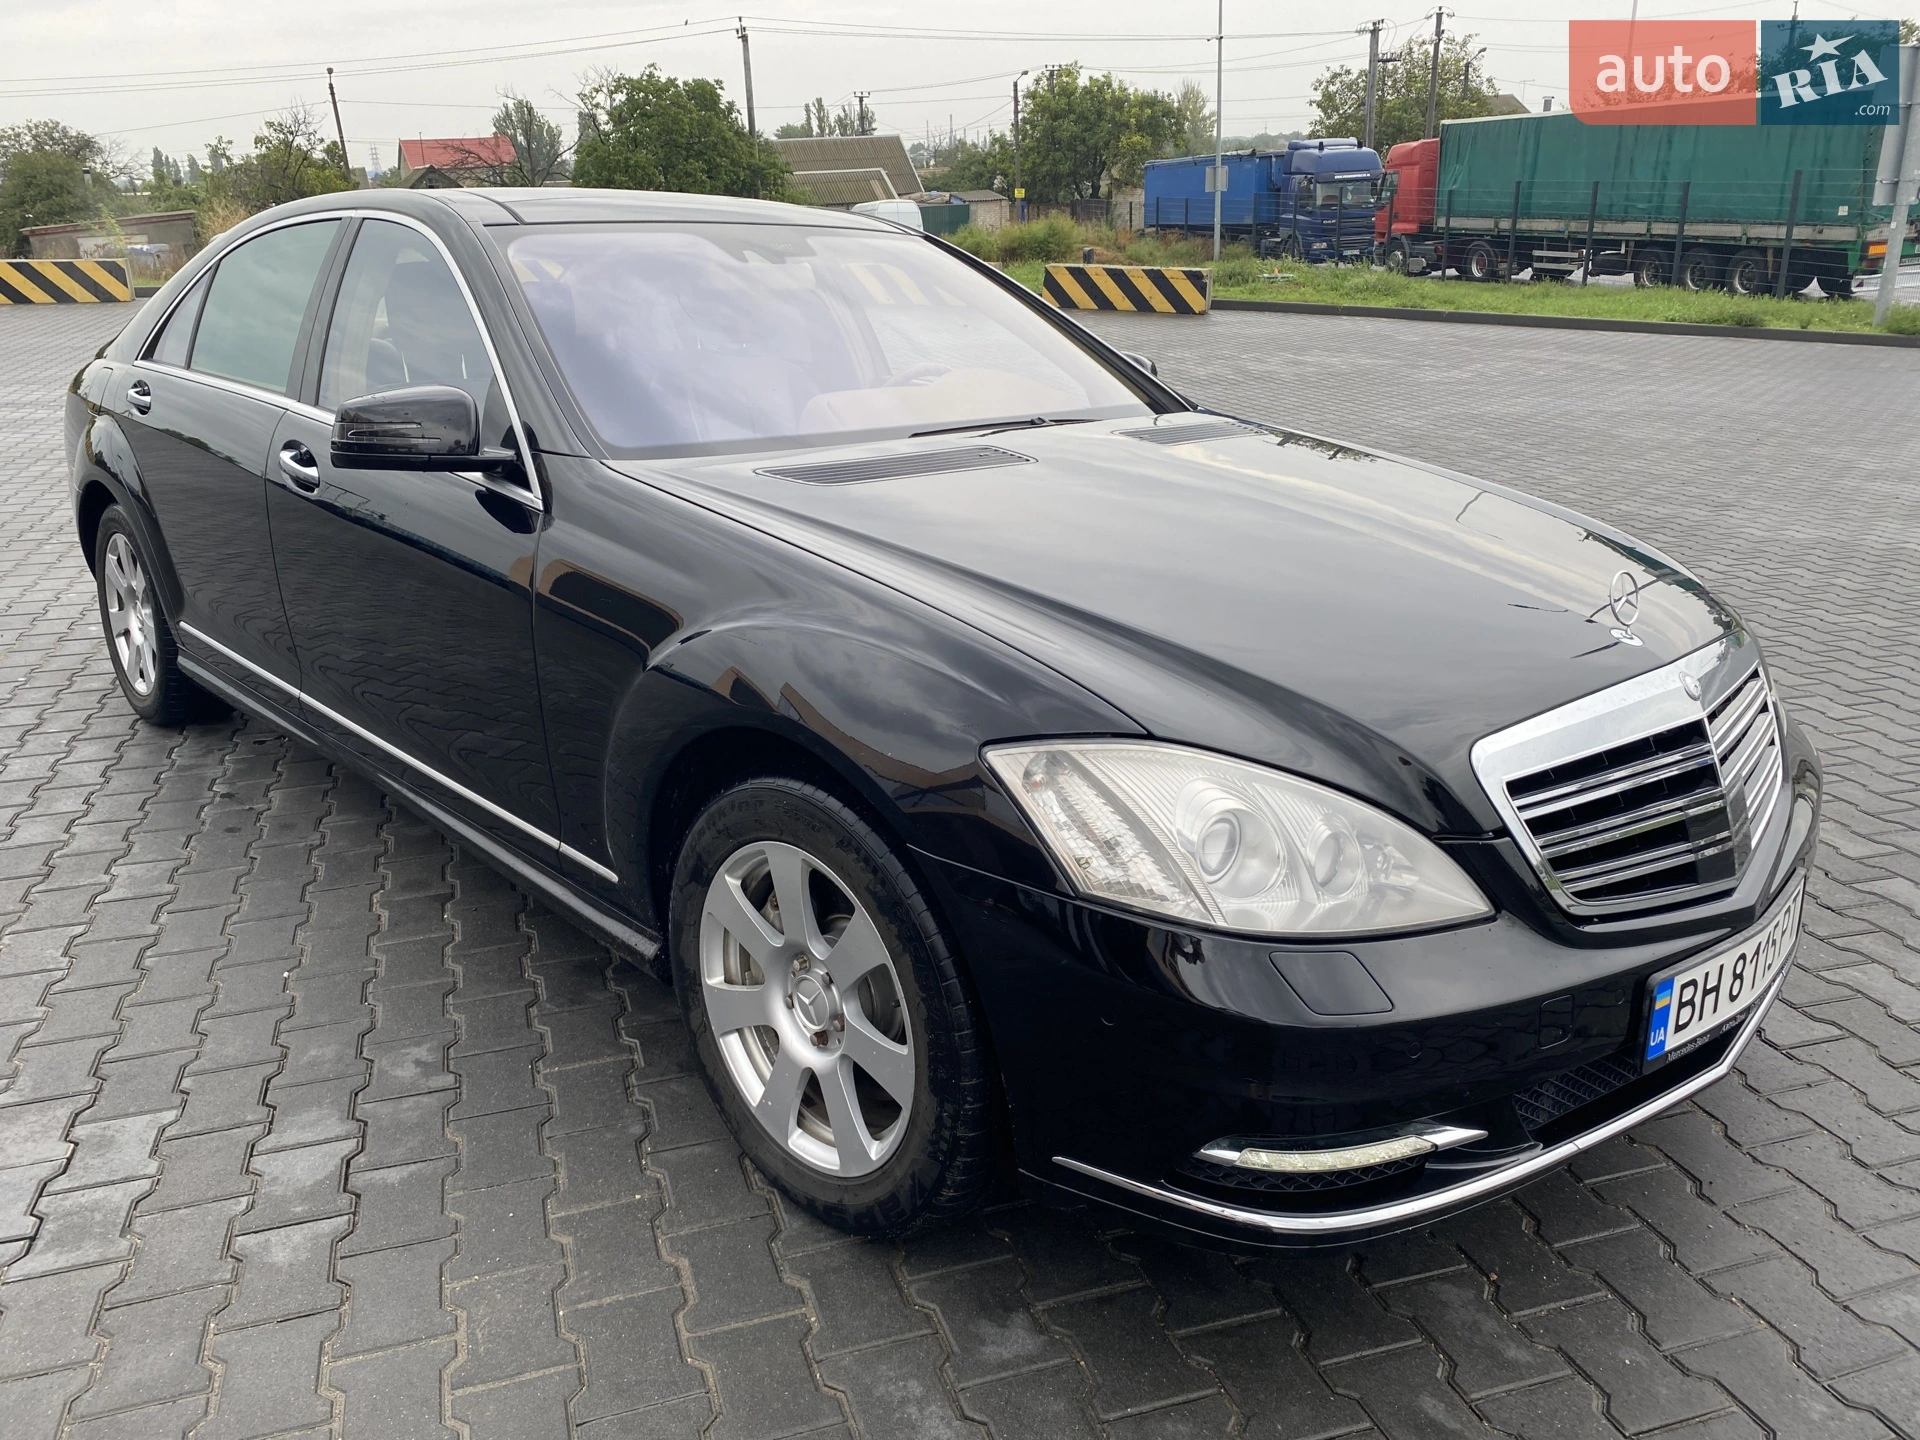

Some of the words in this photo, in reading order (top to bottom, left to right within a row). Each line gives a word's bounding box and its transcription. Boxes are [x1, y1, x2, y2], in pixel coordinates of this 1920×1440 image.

[1673, 962, 1725, 1035] BH
[1728, 921, 1779, 1003] 8115
[1650, 1026, 1665, 1047] UA
